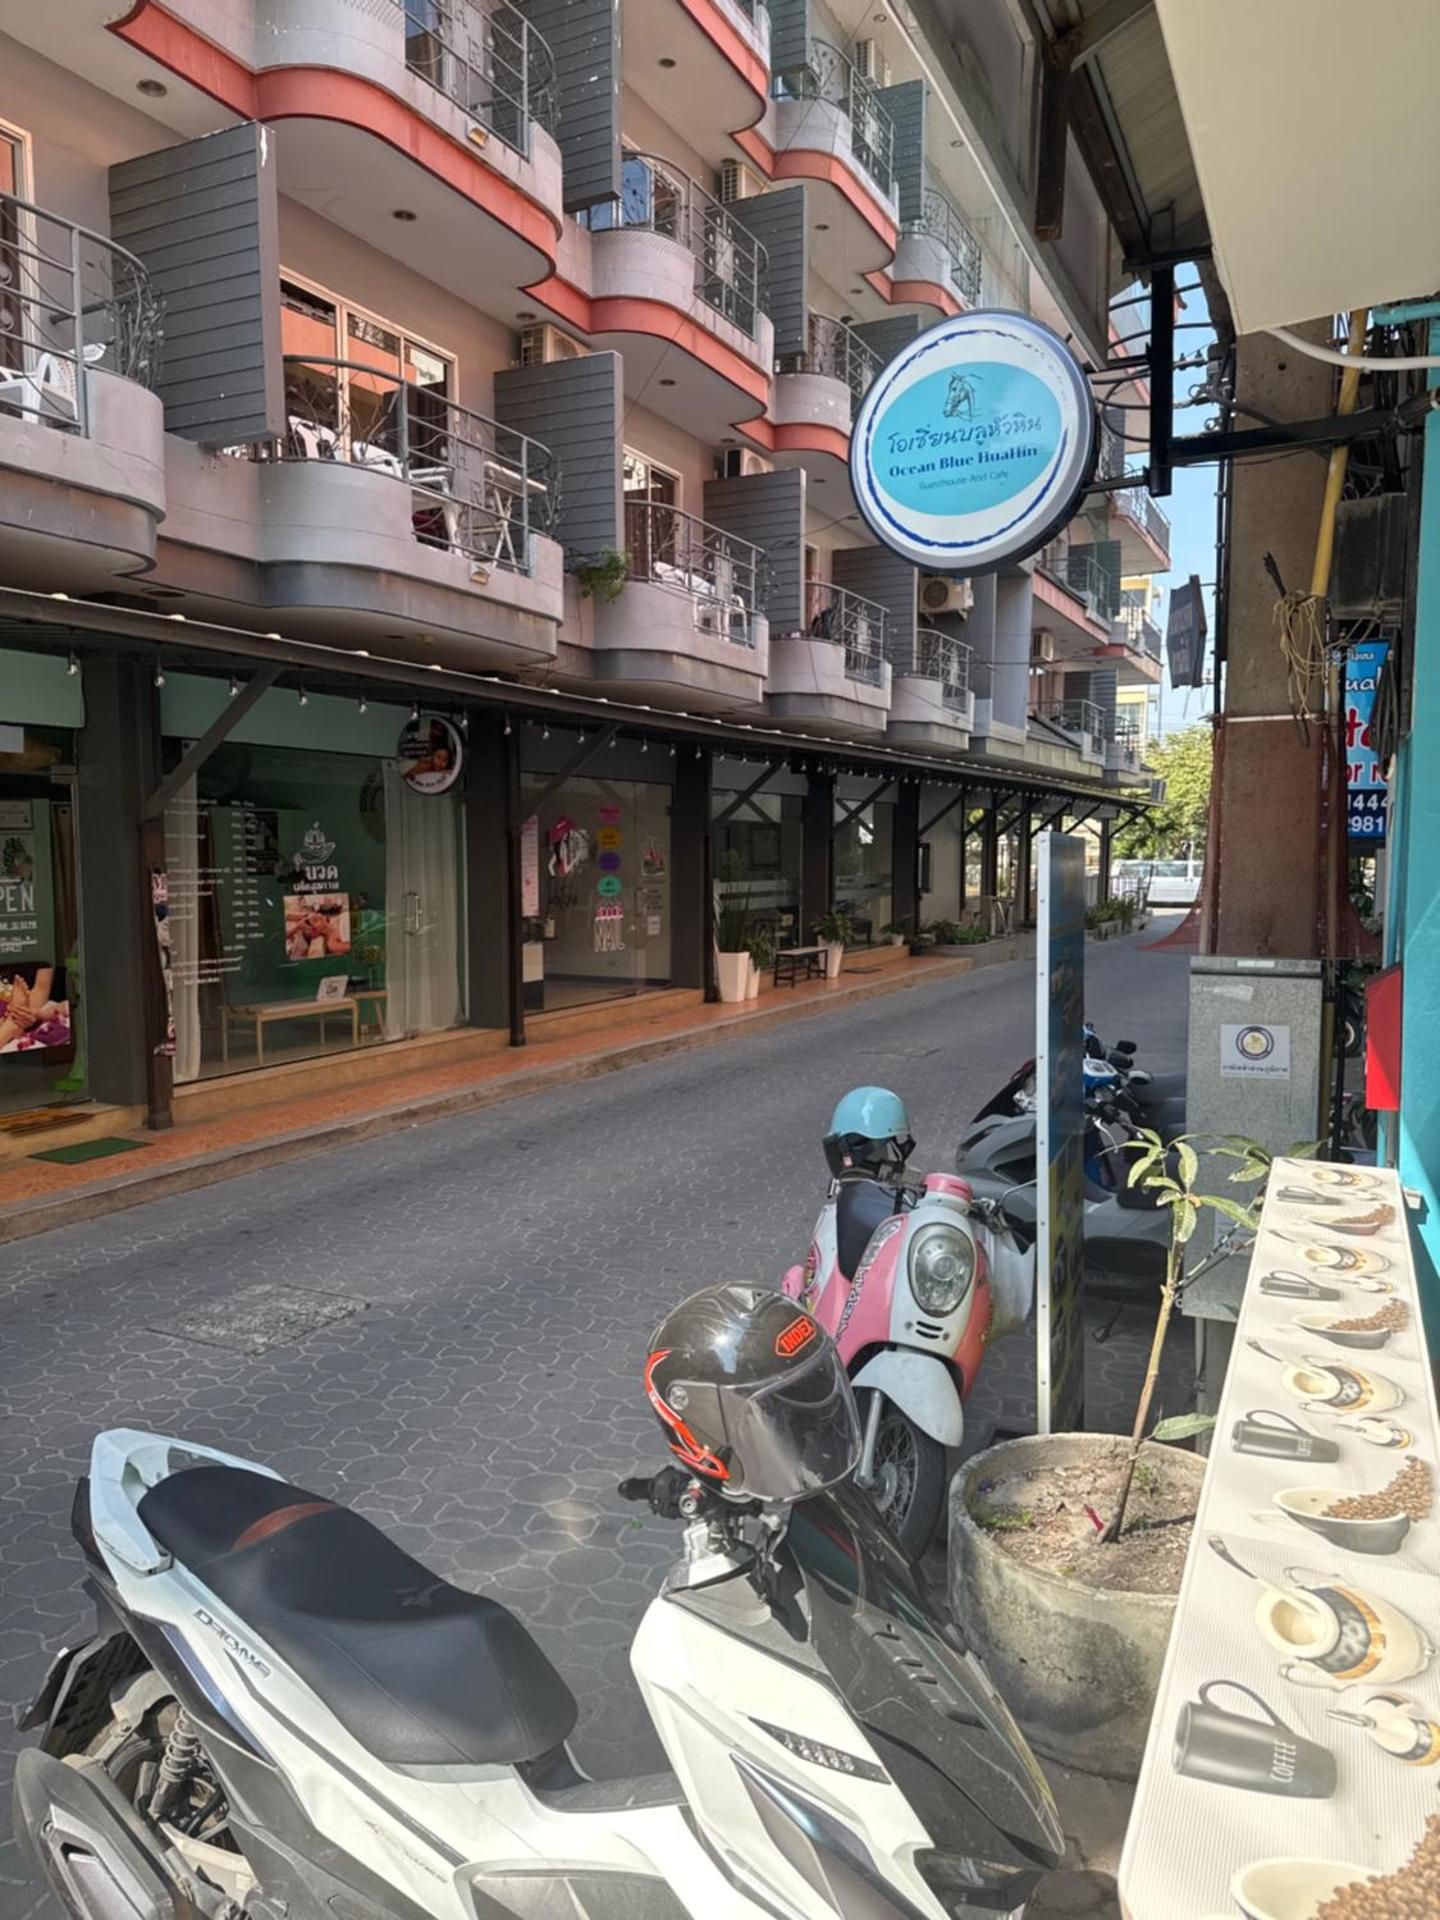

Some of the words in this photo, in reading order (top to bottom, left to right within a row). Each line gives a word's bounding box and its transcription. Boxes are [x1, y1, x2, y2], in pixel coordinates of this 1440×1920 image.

[889, 462, 936, 478] Ocean
[939, 455, 974, 470] Blue
[978, 445, 1038, 464] HuaHin
[970, 471, 987, 482] And
[1348, 815, 1384, 833] 981
[1270, 1740, 1296, 1784] COFFEE
